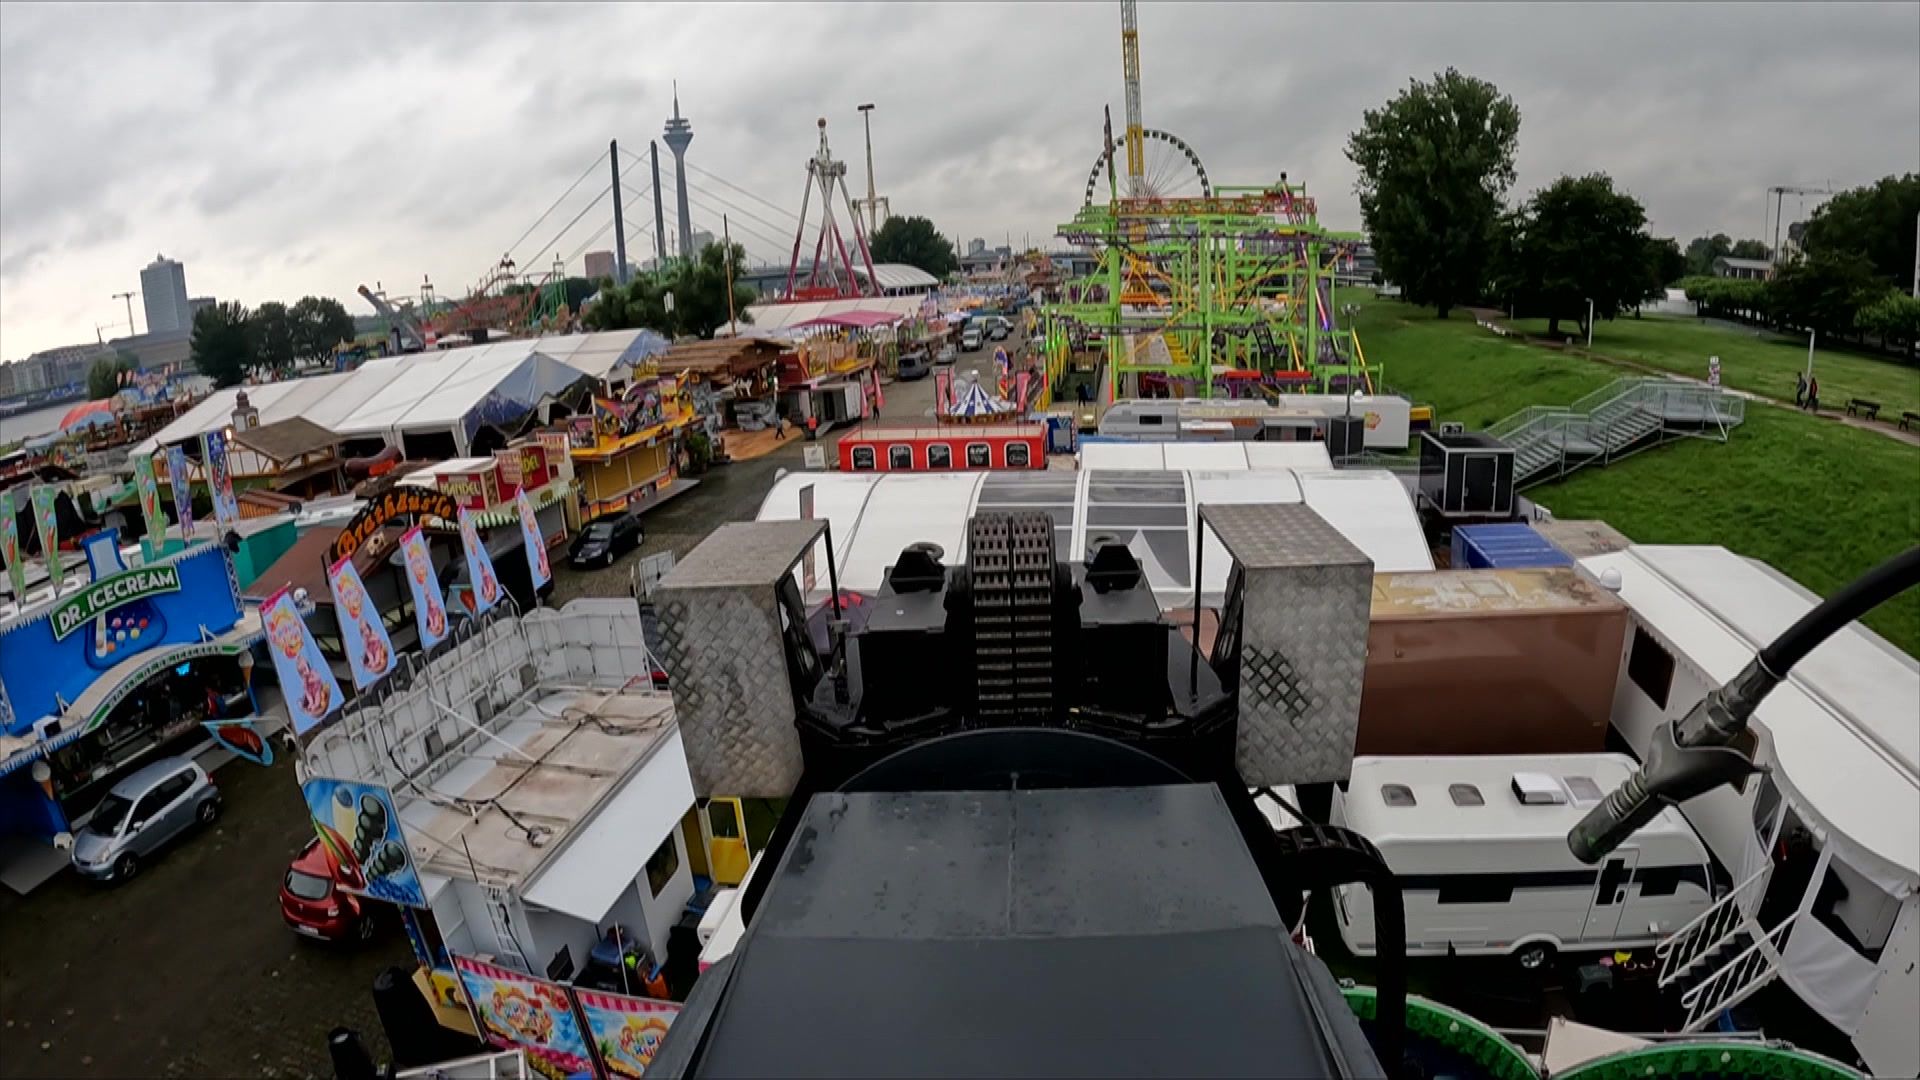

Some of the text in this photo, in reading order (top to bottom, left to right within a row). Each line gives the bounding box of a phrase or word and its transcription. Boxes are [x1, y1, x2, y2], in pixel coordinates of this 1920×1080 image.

[439, 481, 482, 497] MANDEL
[58, 569, 176, 633] DR. ICECREAM
